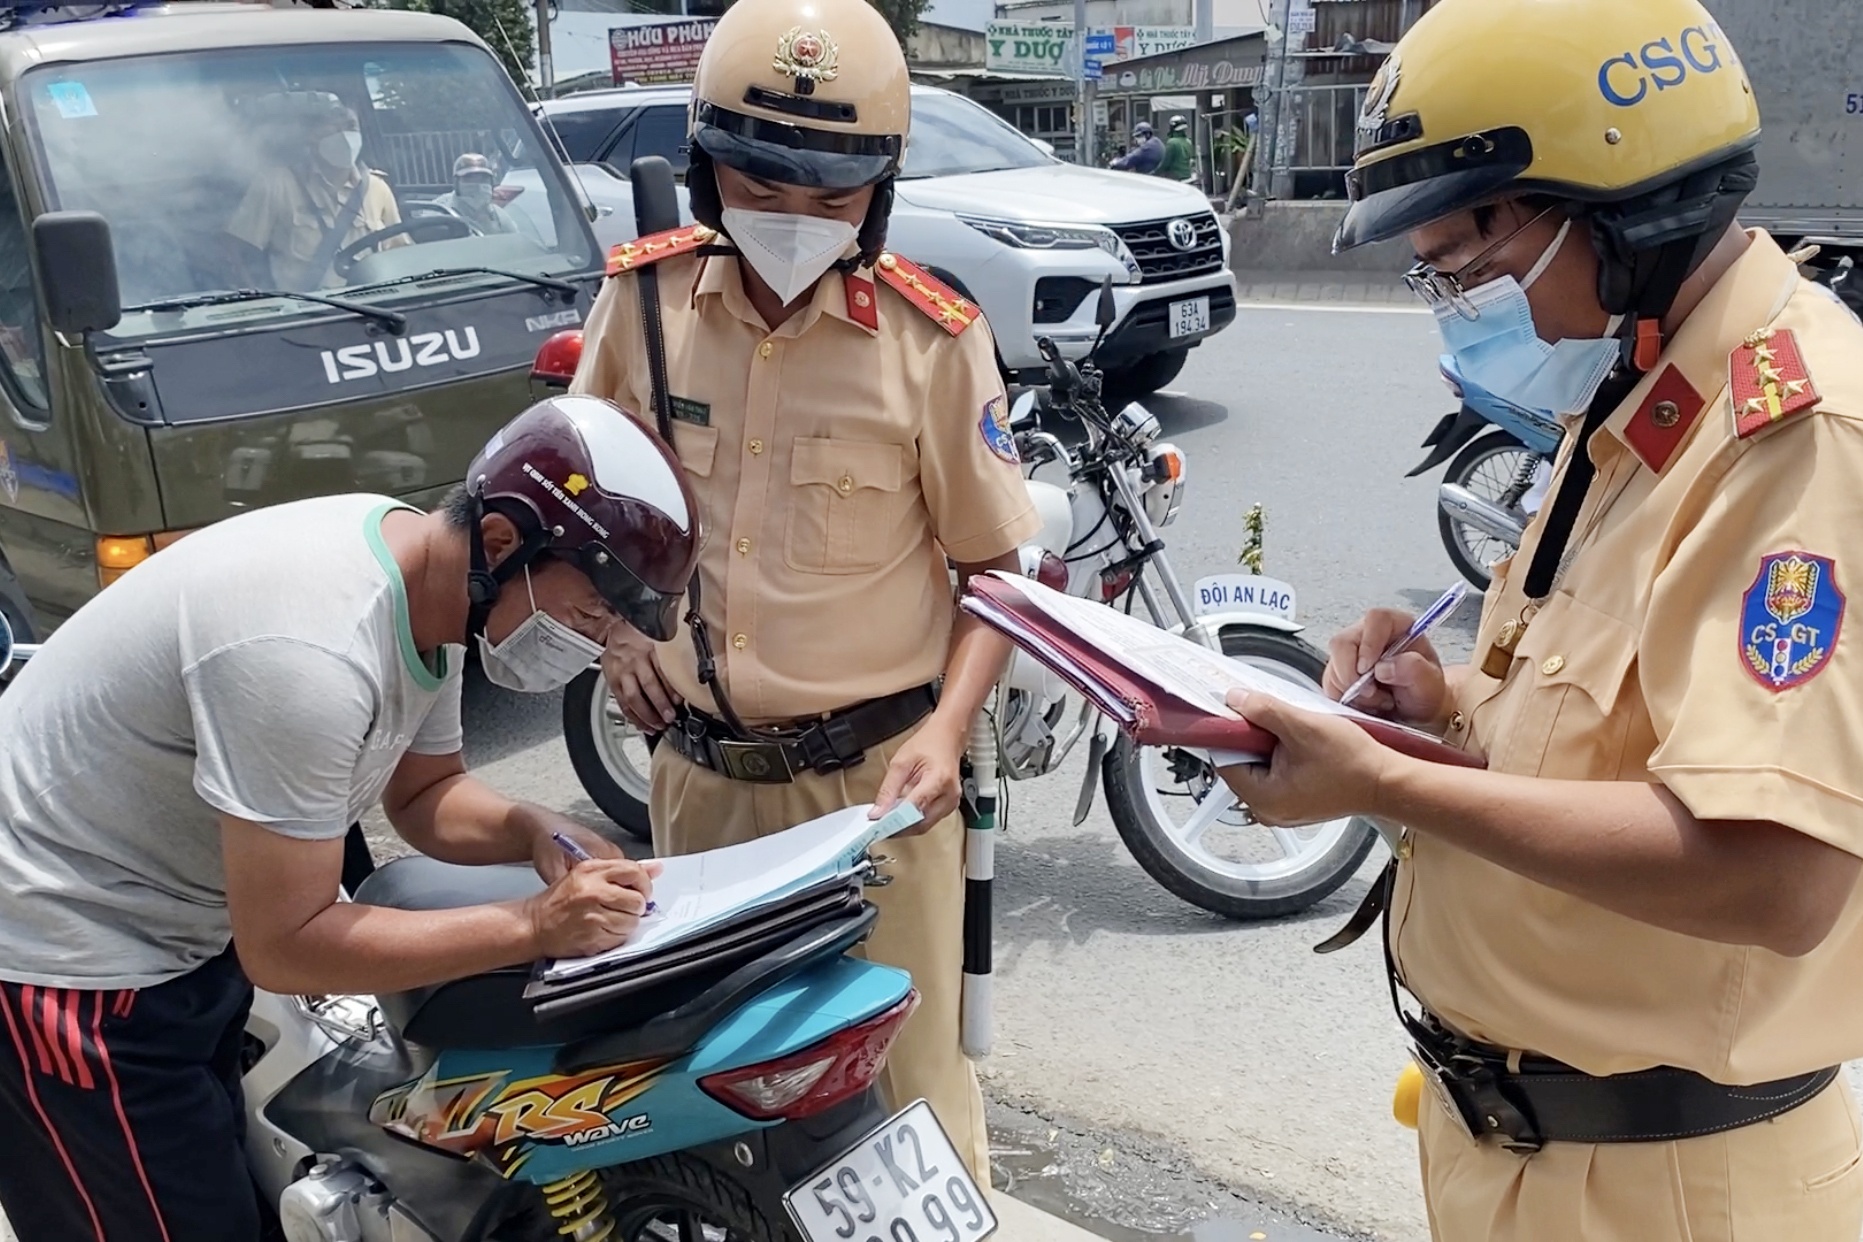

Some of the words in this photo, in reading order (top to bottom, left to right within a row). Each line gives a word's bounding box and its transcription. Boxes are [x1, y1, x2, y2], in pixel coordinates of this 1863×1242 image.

[999, 25, 1019, 36] NHÀ
[1022, 27, 1053, 38] THUỐC
[1056, 28, 1074, 39] TÂY
[989, 40, 1005, 57] Y
[1138, 43, 1150, 55] Y
[1181, 302, 1199, 317] 63A
[320, 326, 481, 384] ISUZU
[1200, 582, 1228, 606] ĐỘI
[1233, 586, 1254, 603] AN
[1260, 588, 1290, 610] LẠC
[1751, 622, 1778, 644] CS
[1791, 623, 1820, 647] GT
[494, 1076, 616, 1146] RS
[812, 1123, 940, 1239] 59-K2
[866, 1175, 984, 1242] 99
